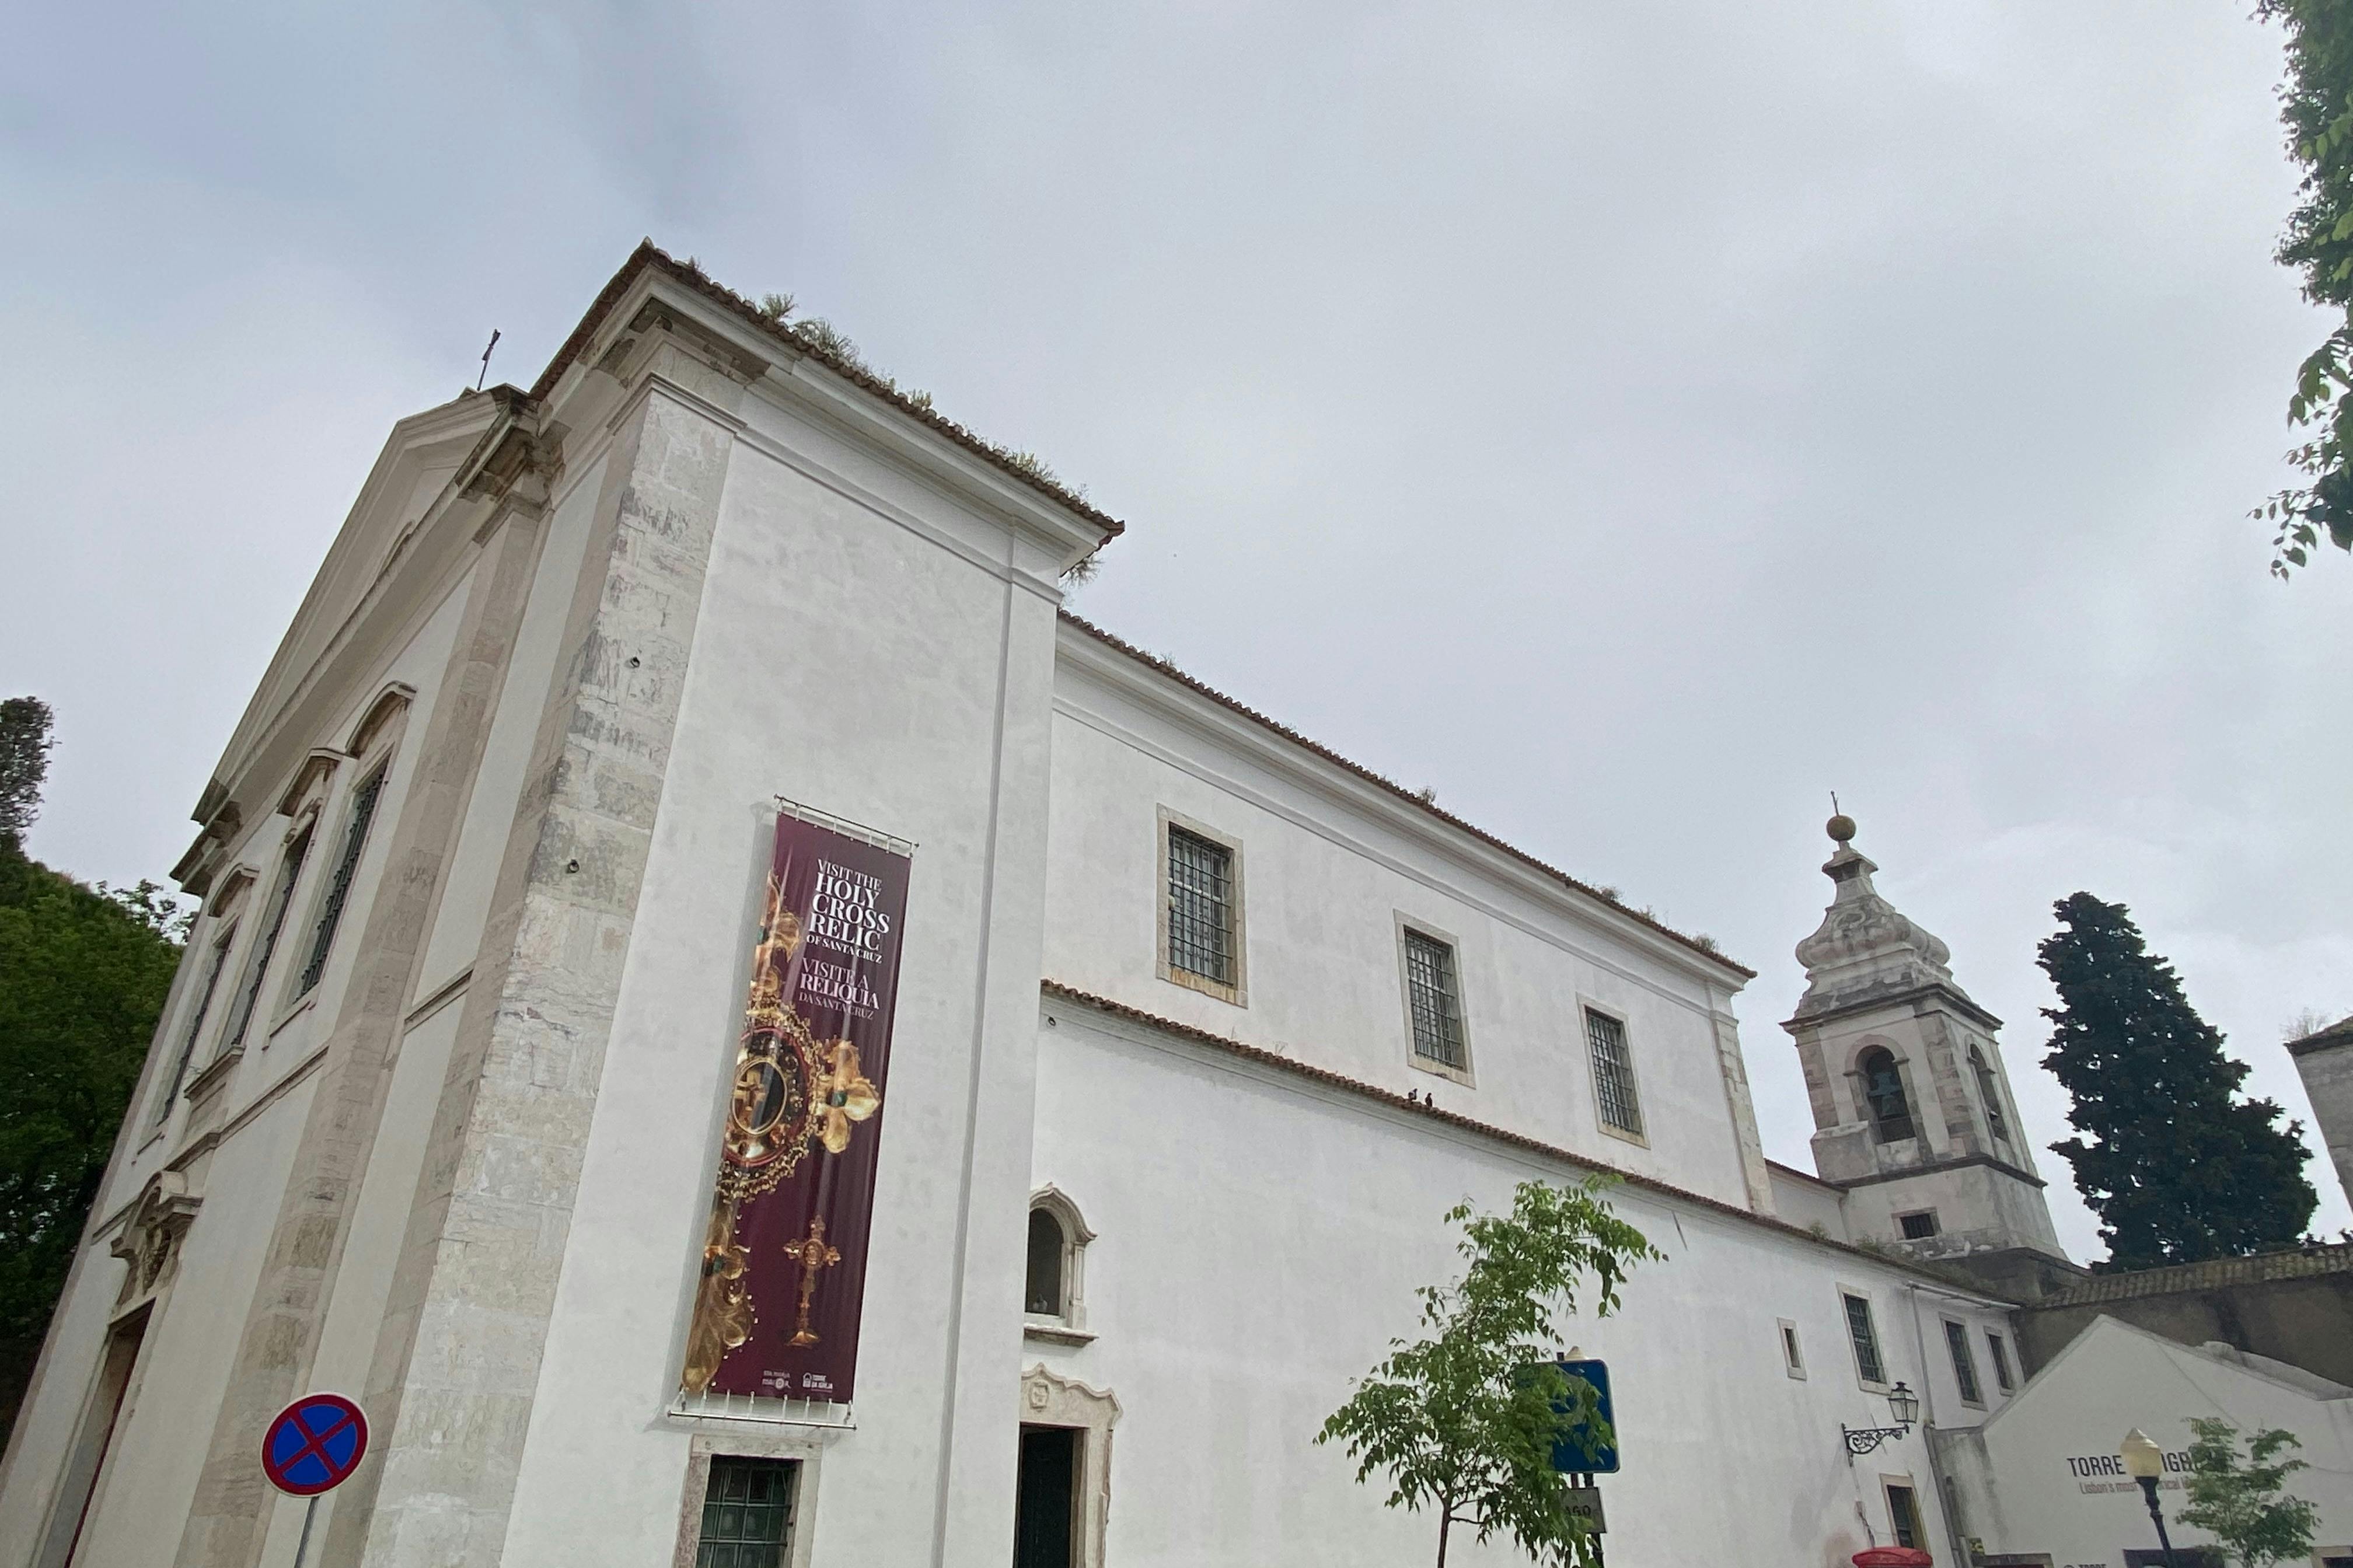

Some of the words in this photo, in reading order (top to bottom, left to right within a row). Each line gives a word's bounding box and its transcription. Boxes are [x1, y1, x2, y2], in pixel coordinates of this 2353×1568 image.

[815, 872, 879, 909] HOLY
[818, 858, 853, 881] VISIT
[855, 872, 882, 892] THE
[812, 893, 891, 934] CROSS
[808, 912, 881, 951] RELIC
[807, 934, 822, 945] OF
[822, 938, 854, 955] SANTA
[856, 948, 882, 964] CRUZ
[802, 958, 855, 986] VISITE
[857, 975, 869, 990] A
[798, 993, 813, 1004] DA
[815, 996, 846, 1012] SANTA
[848, 1005, 874, 1019] CRUZ
[2066, 1455, 2126, 1477] TORRE
